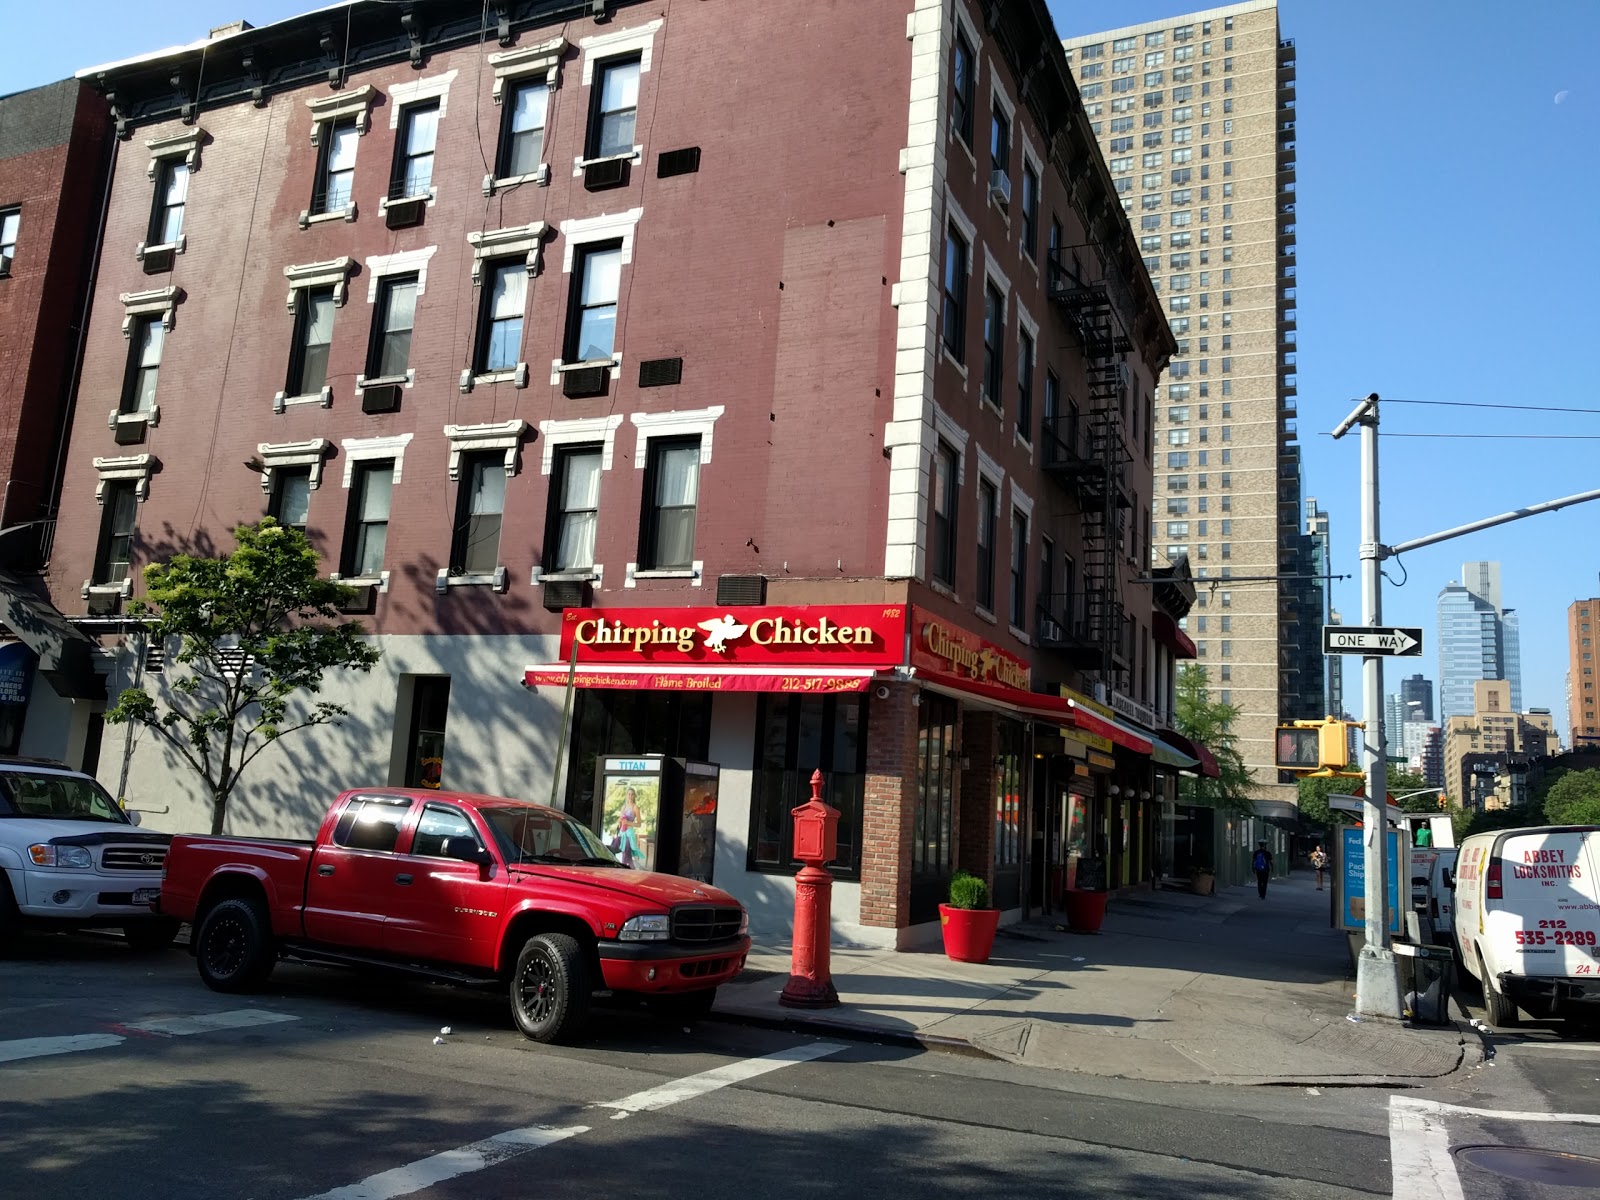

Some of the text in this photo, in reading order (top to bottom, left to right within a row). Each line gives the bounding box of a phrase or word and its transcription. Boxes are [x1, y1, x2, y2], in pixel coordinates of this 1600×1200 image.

[882, 608, 901, 618] 1982
[574, 617, 874, 652] Chirping Chicken
[1338, 635, 1407, 648] ONE WAY
[928, 622, 979, 679] Chirping
[534, 673, 638, 686] www.chipingchicken.com
[655, 675, 684, 688] Flame
[686, 676, 722, 689] Broiled
[619, 761, 646, 770] TITAN
[1348, 837, 1363, 845] Fed
[1524, 850, 1565, 863] ABBEY
[1348, 869, 1364, 879] Ship
[1514, 865, 1582, 879] LOCKSMITHS
[1538, 919, 1567, 929] 212
[1515, 931, 1597, 946] 535-2289
[1575, 964, 1591, 974] 24
